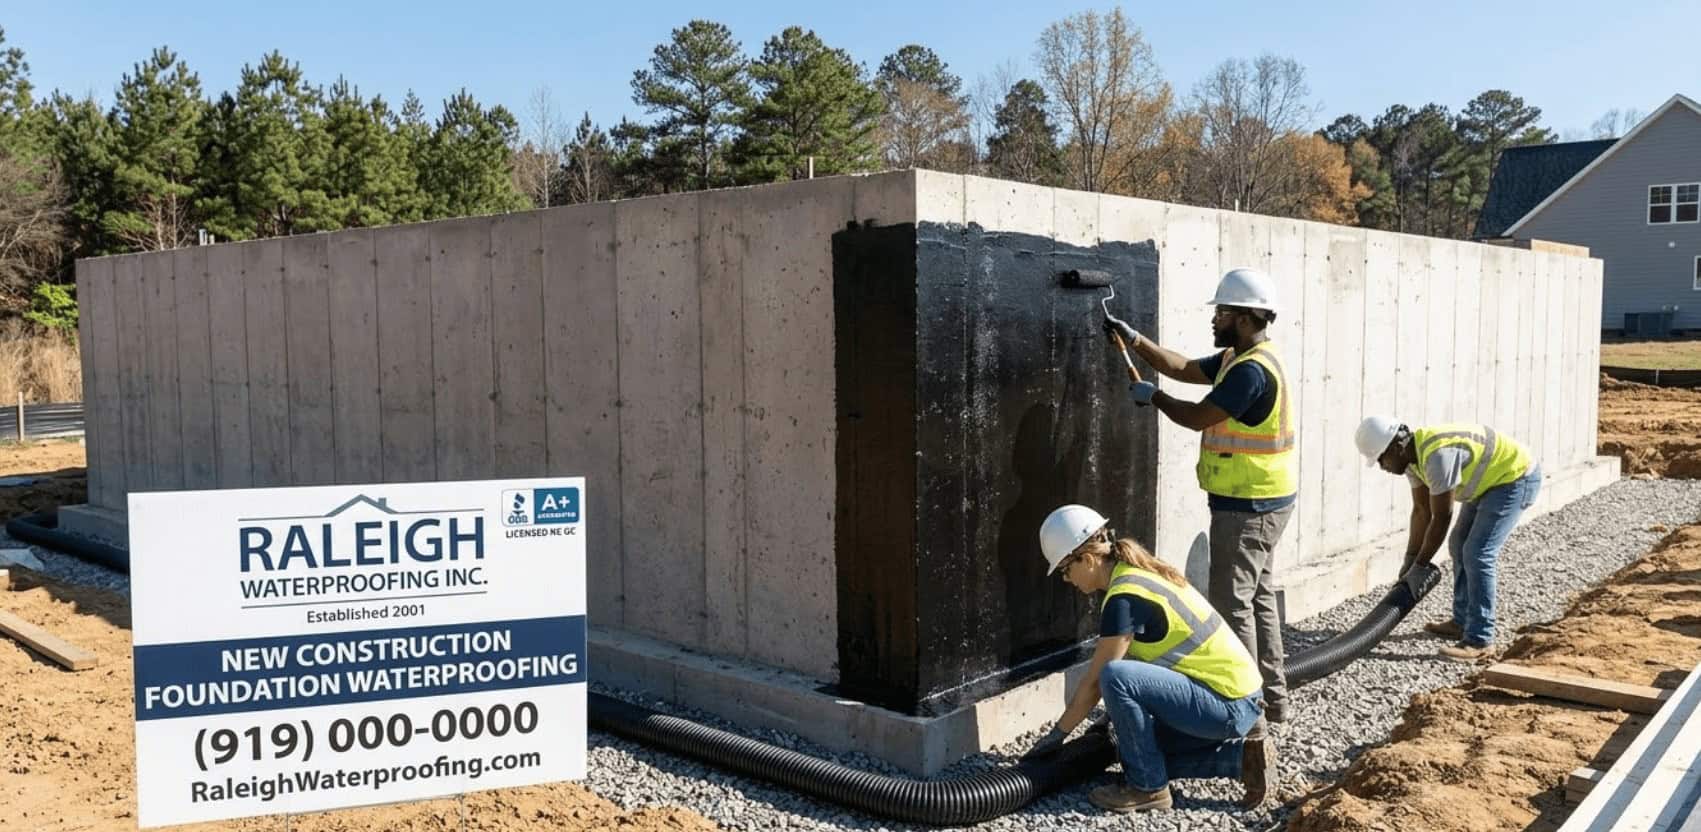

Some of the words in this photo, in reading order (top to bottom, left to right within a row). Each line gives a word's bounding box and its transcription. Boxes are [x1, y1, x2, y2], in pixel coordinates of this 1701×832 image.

[541, 493, 570, 511] A+
[239, 517, 485, 573] RALEIGH
[505, 528, 548, 539] LICENSED
[563, 526, 576, 536] GC
[240, 570, 439, 599] WATERPROOFING
[445, 567, 488, 587] INC.
[306, 607, 389, 624] Established
[392, 604, 426, 618] 2001
[221, 645, 289, 673] NEW
[296, 629, 512, 667] CONSTRUCTION
[145, 675, 341, 709] FOUNDATION
[346, 653, 578, 694] WATERPROOFING
[193, 719, 315, 772] (919)
[328, 701, 539, 753] 000-0000
[191, 750, 541, 803] RaleighWaterproofing.com
